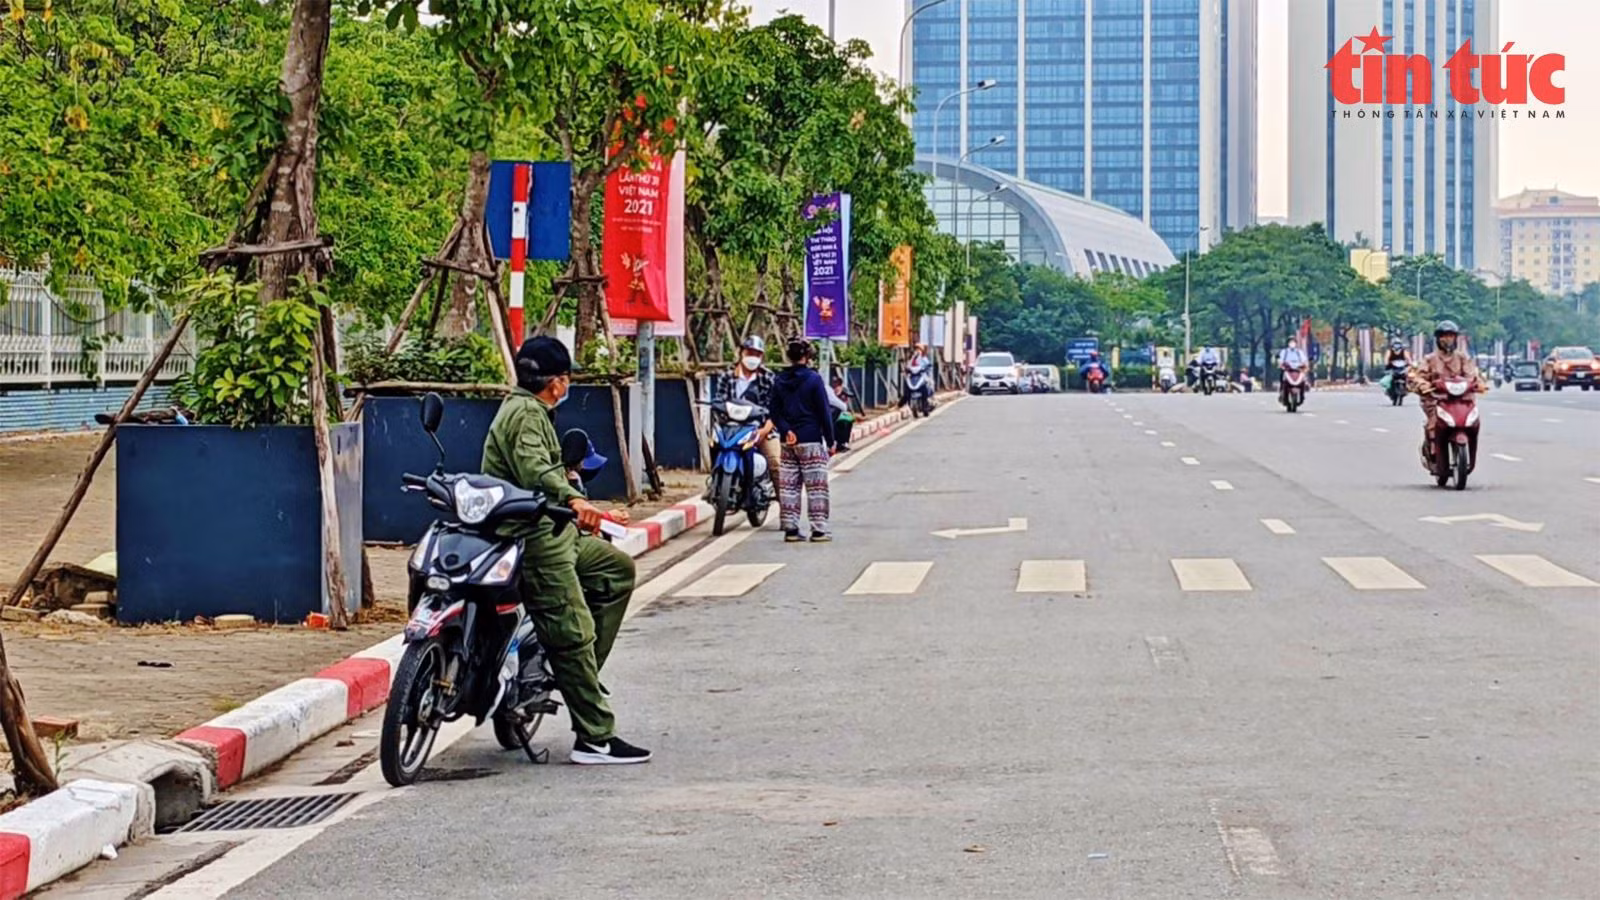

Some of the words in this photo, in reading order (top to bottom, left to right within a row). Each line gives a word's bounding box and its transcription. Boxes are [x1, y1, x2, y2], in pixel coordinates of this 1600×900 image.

[638, 187, 659, 198] NAM
[624, 199, 654, 216] 2021
[813, 266, 834, 276] 2021
